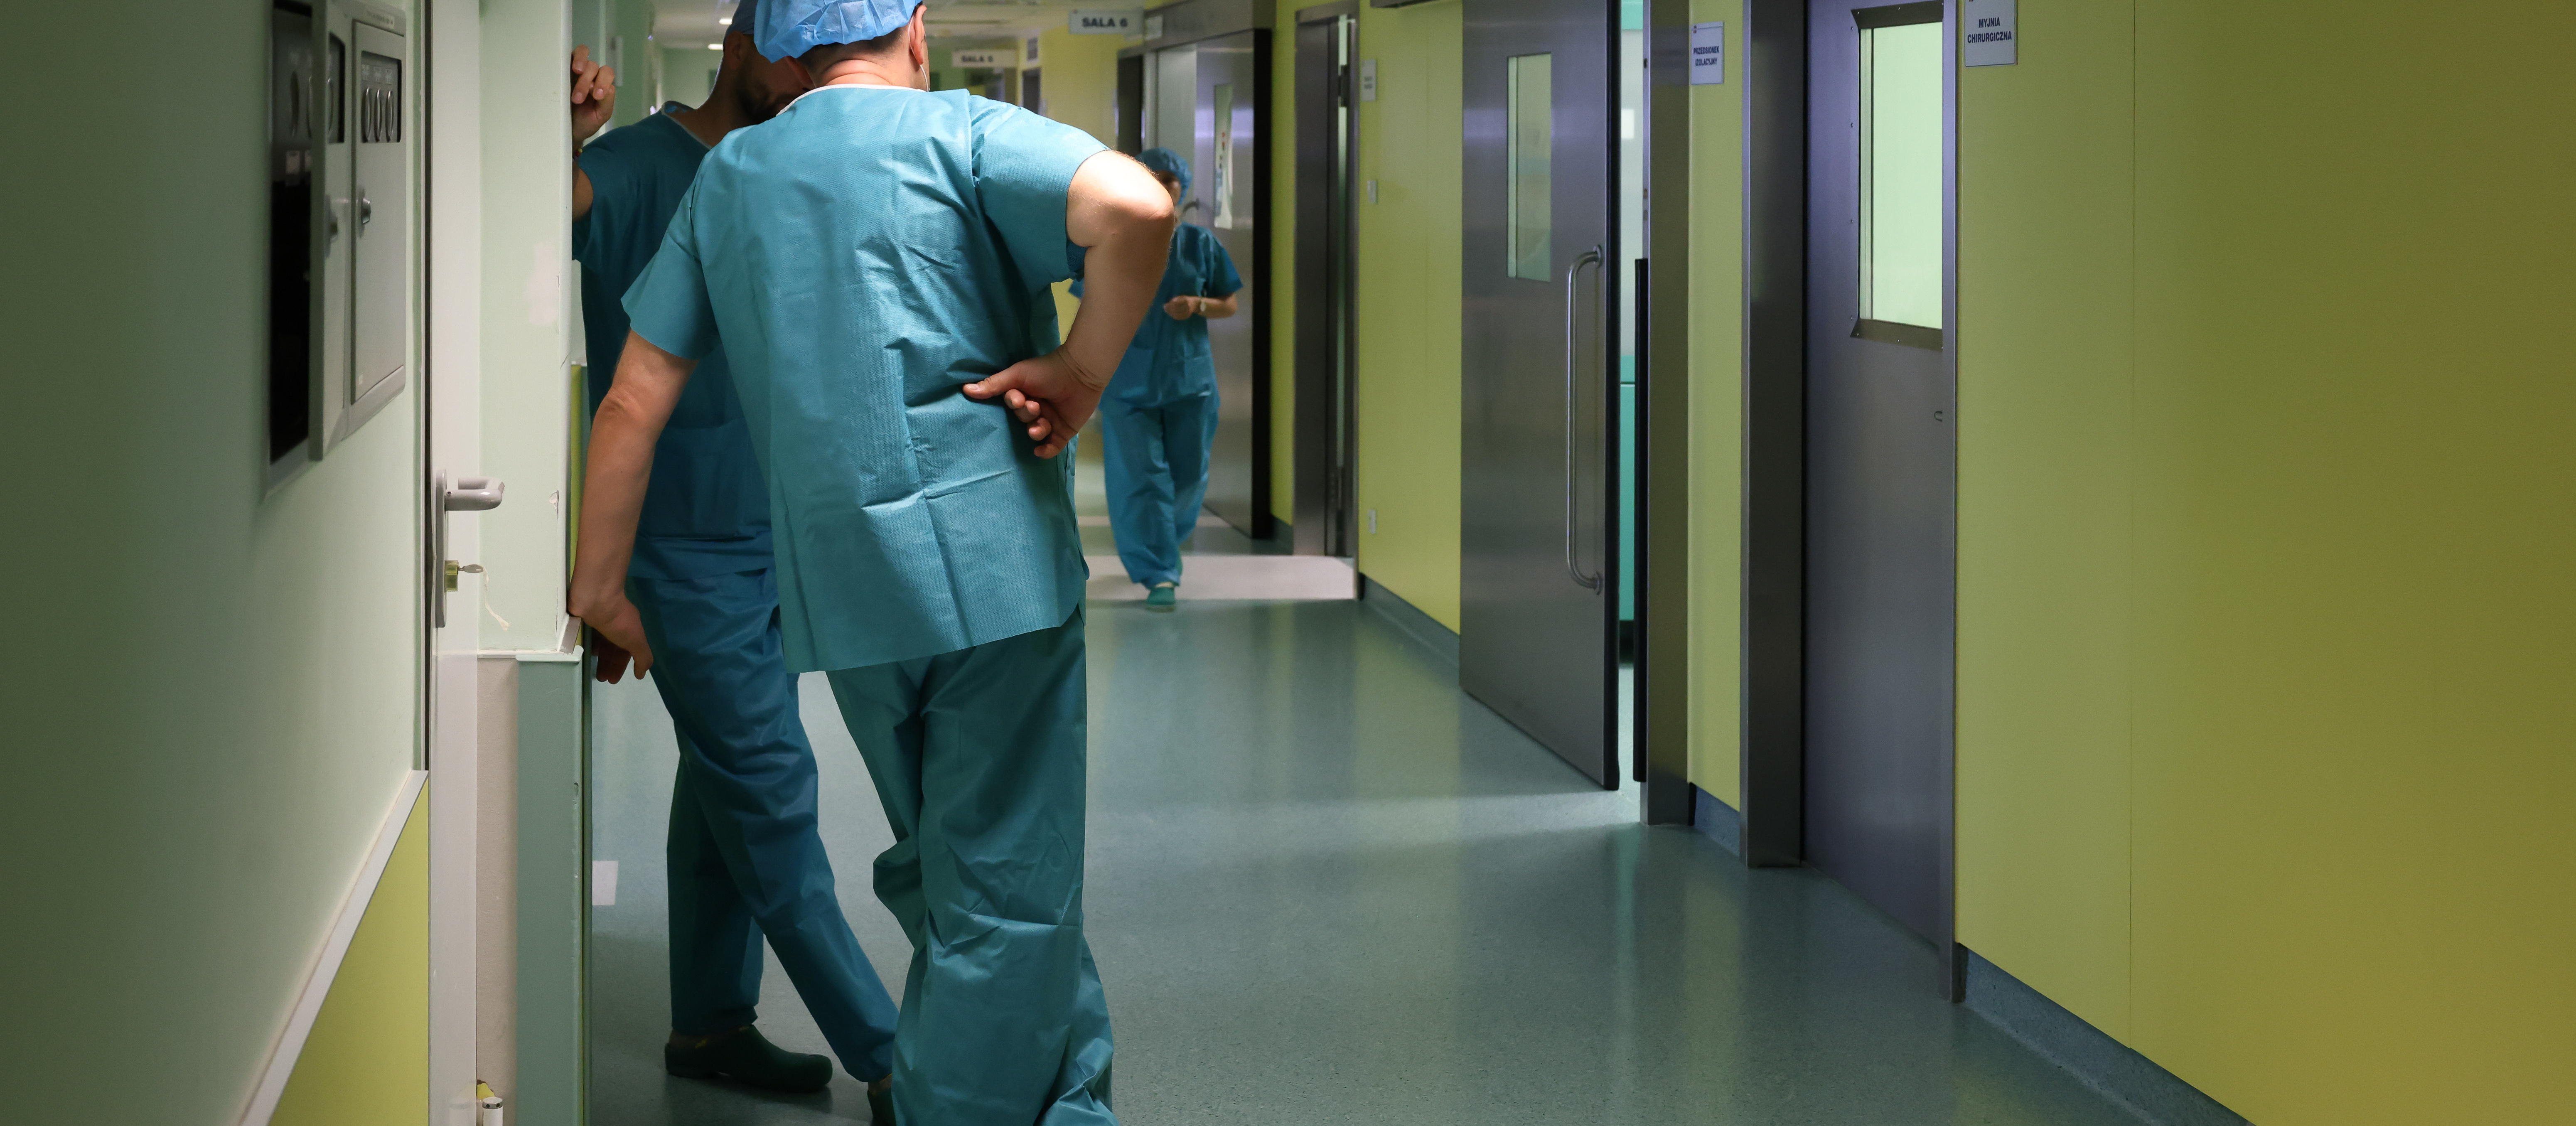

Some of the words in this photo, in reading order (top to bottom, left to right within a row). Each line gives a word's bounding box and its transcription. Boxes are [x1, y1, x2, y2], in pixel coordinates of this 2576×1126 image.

[1082, 17, 1116, 27] SALA
[1979, 17, 2000, 28] MYJNIA
[1967, 31, 2012, 44] CHIRURGICZNA
[1694, 46, 1720, 55] PRZEDSIONEK
[1695, 57, 1718, 66] IZOLACYJNY
